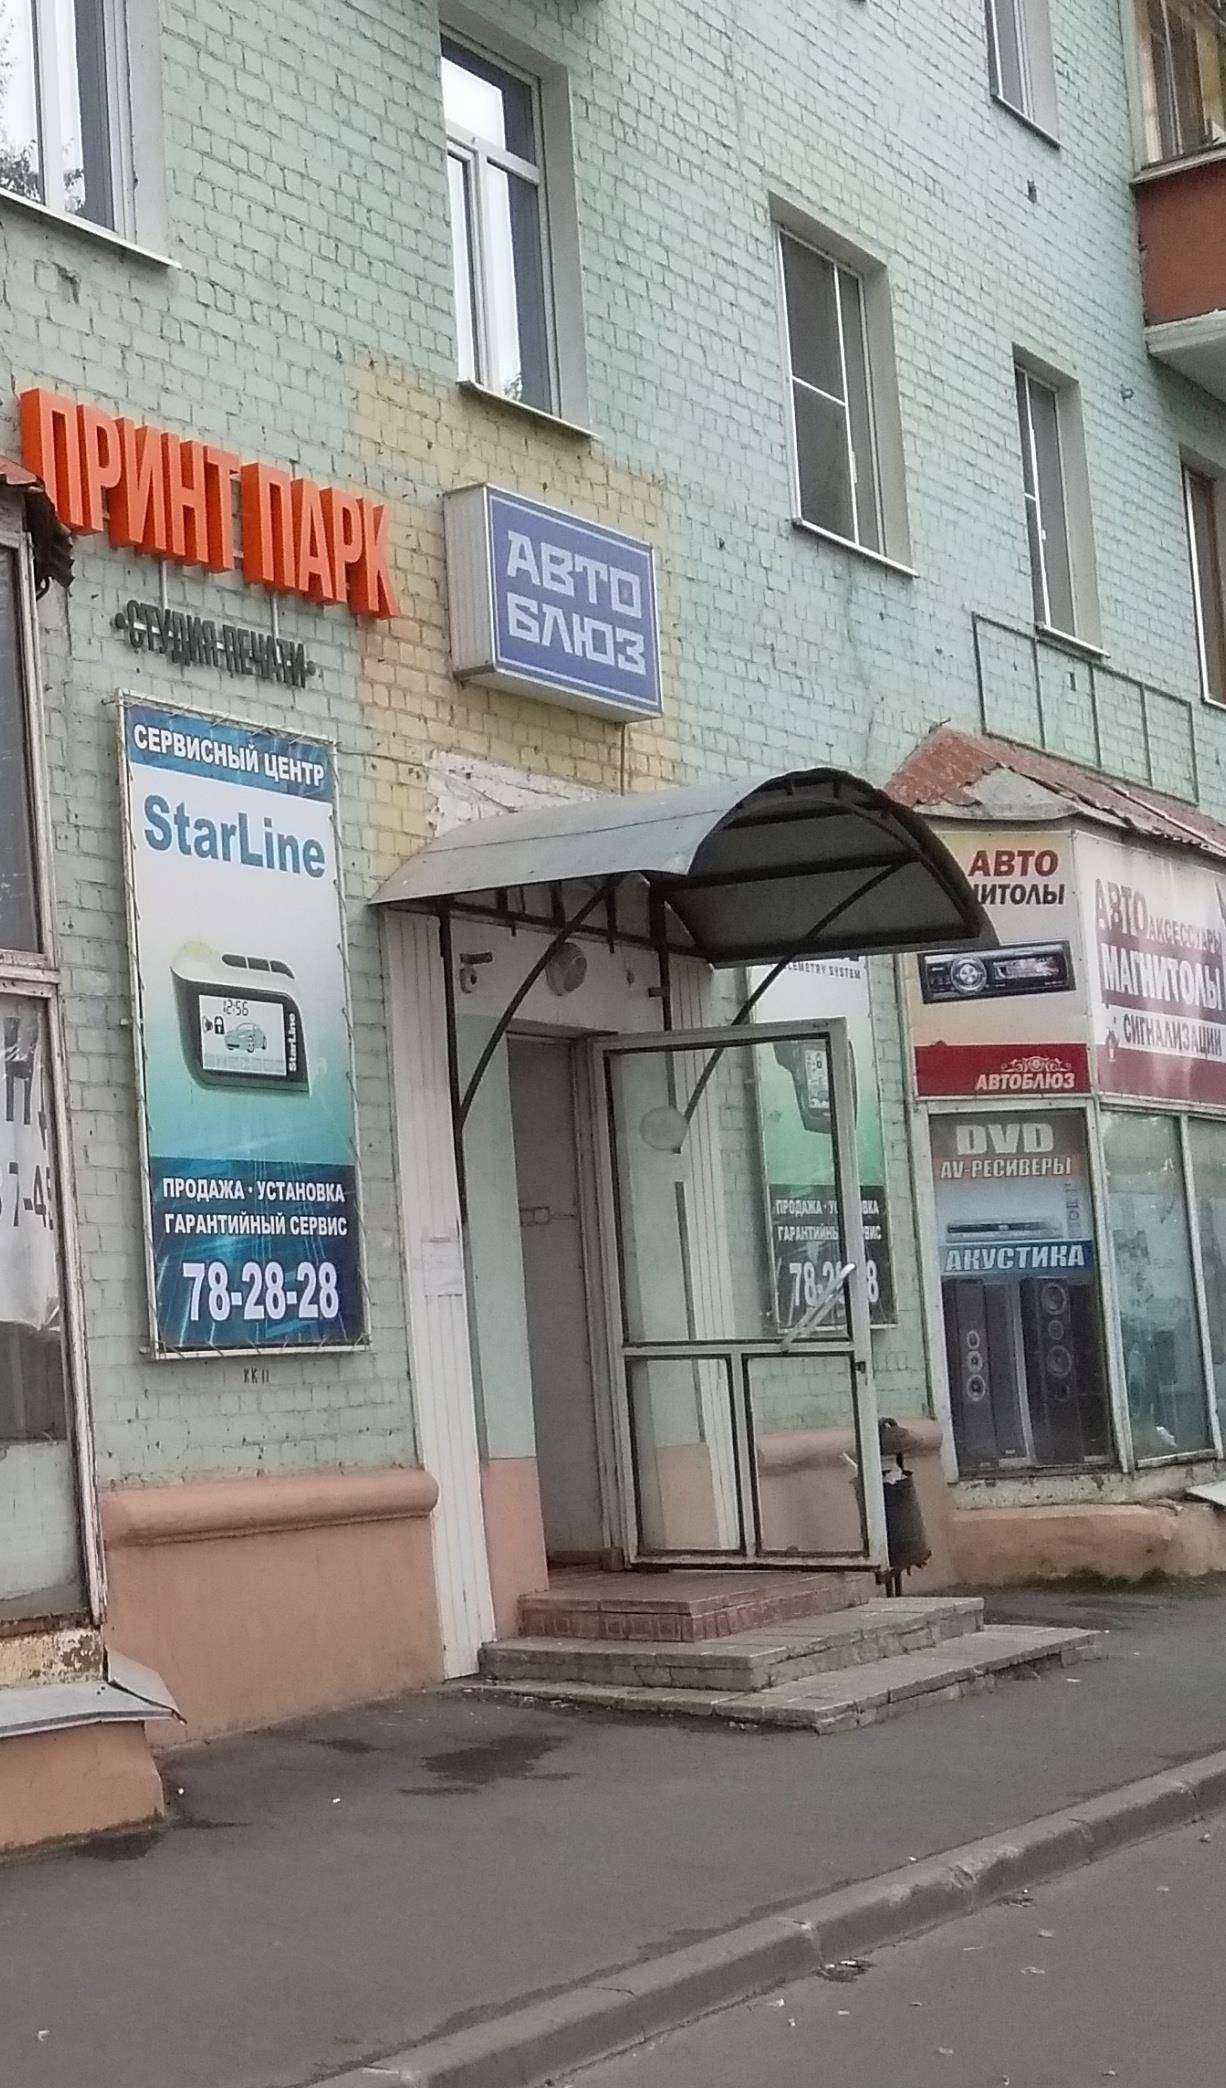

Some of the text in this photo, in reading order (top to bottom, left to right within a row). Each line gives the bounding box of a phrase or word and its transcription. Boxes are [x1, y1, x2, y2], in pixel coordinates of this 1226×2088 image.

[20, 388, 398, 619] ПРИНТ ПАРК
[507, 530, 642, 619] АВТО
[507, 592, 646, 676] БЛЮЗ
[133, 724, 326, 788] СЕРВИСНЫЙ ЦЕНТР
[144, 794, 326, 878] StarLine
[968, 850, 1059, 877] АВТО
[973, 883, 1065, 905] ИТОЛЫ
[1100, 942, 1226, 1011] МАГНИТОЛЫ
[975, 1072, 1076, 1092] АВТОБЛЮЗ
[955, 1122, 1055, 1156] DVD
[163, 1177, 346, 1203] ПРОДАЖА УСТАНОВКА
[164, 1211, 348, 1237] ГАРАНТИЙНЫЙ СЕРВИС
[776, 1199, 823, 1217] ПРОДАЖА
[945, 1244, 1086, 1273] АКУСТИКА
[182, 1260, 340, 1322] 78-28-28
